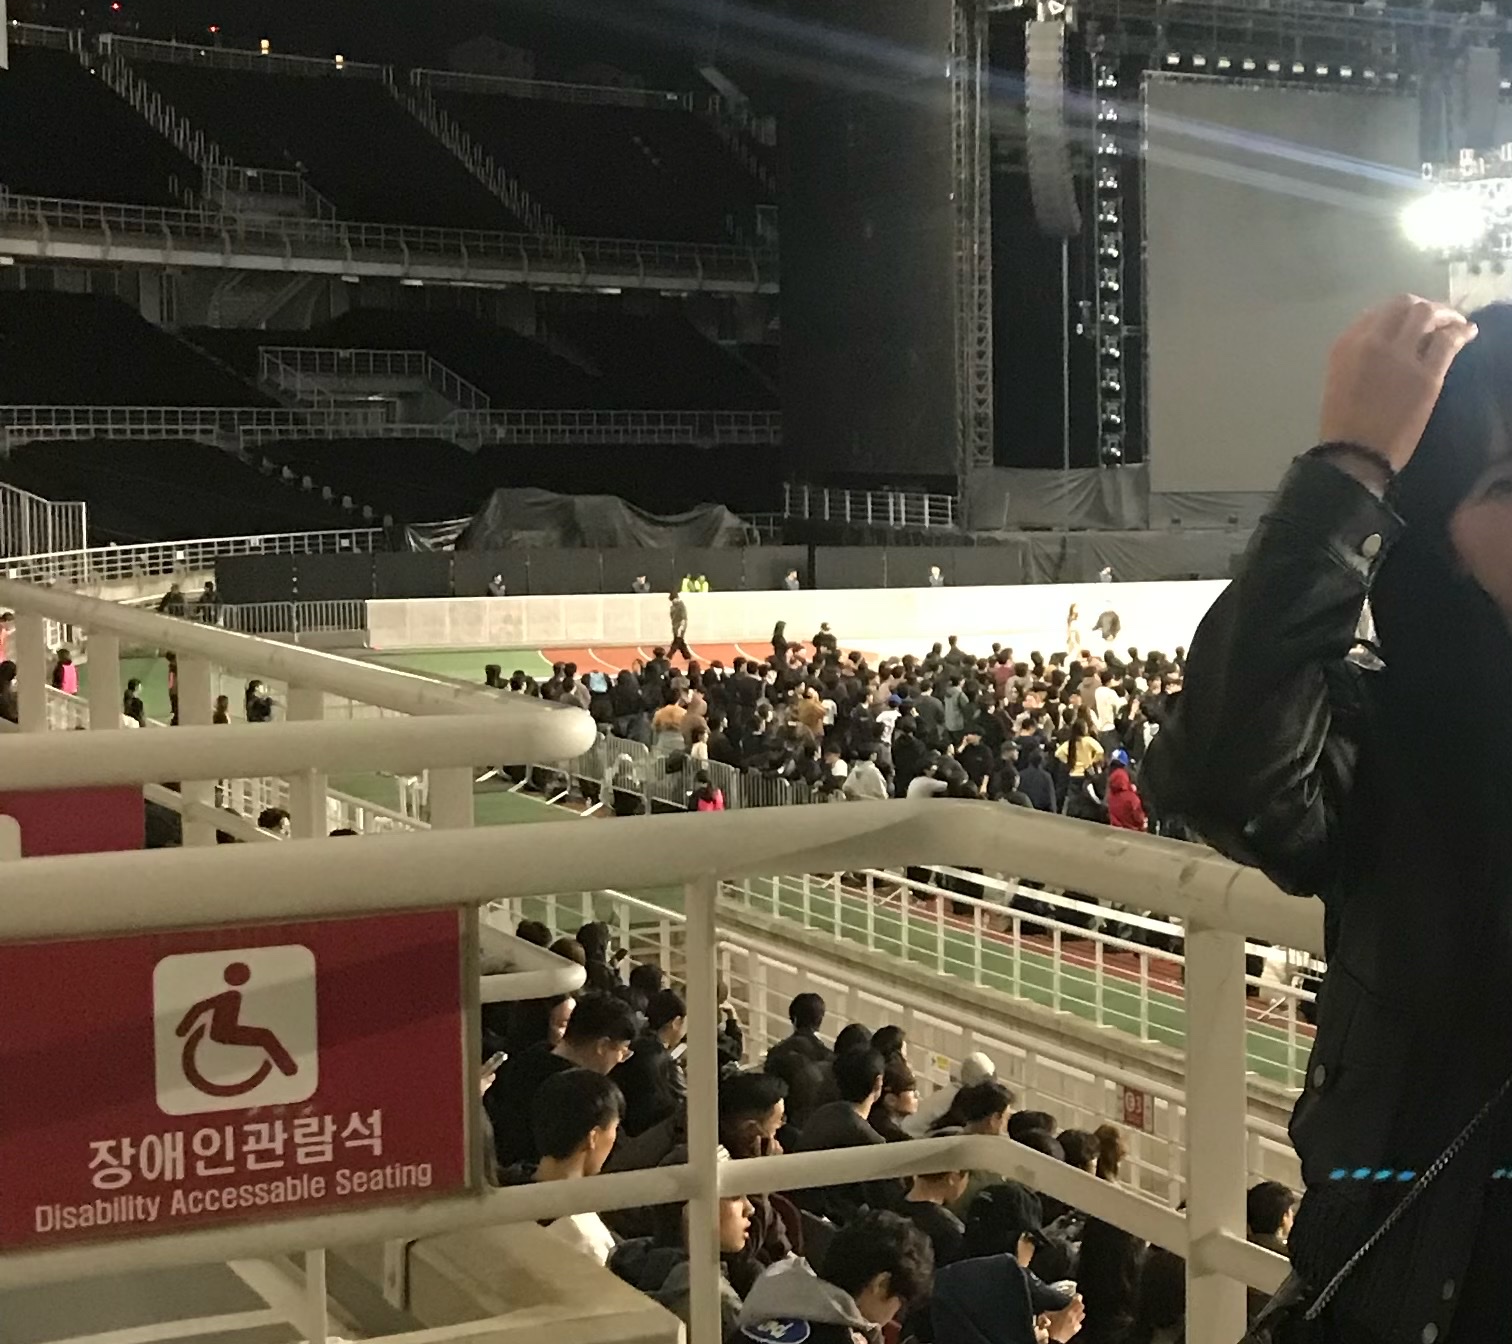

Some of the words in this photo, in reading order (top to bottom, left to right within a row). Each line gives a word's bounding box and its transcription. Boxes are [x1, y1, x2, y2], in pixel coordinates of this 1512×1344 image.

[88, 1109, 384, 1190] 장애인관람석
[35, 1195, 161, 1233] Disability
[170, 1173, 326, 1216] Accessable
[336, 1162, 433, 1196] Seating
